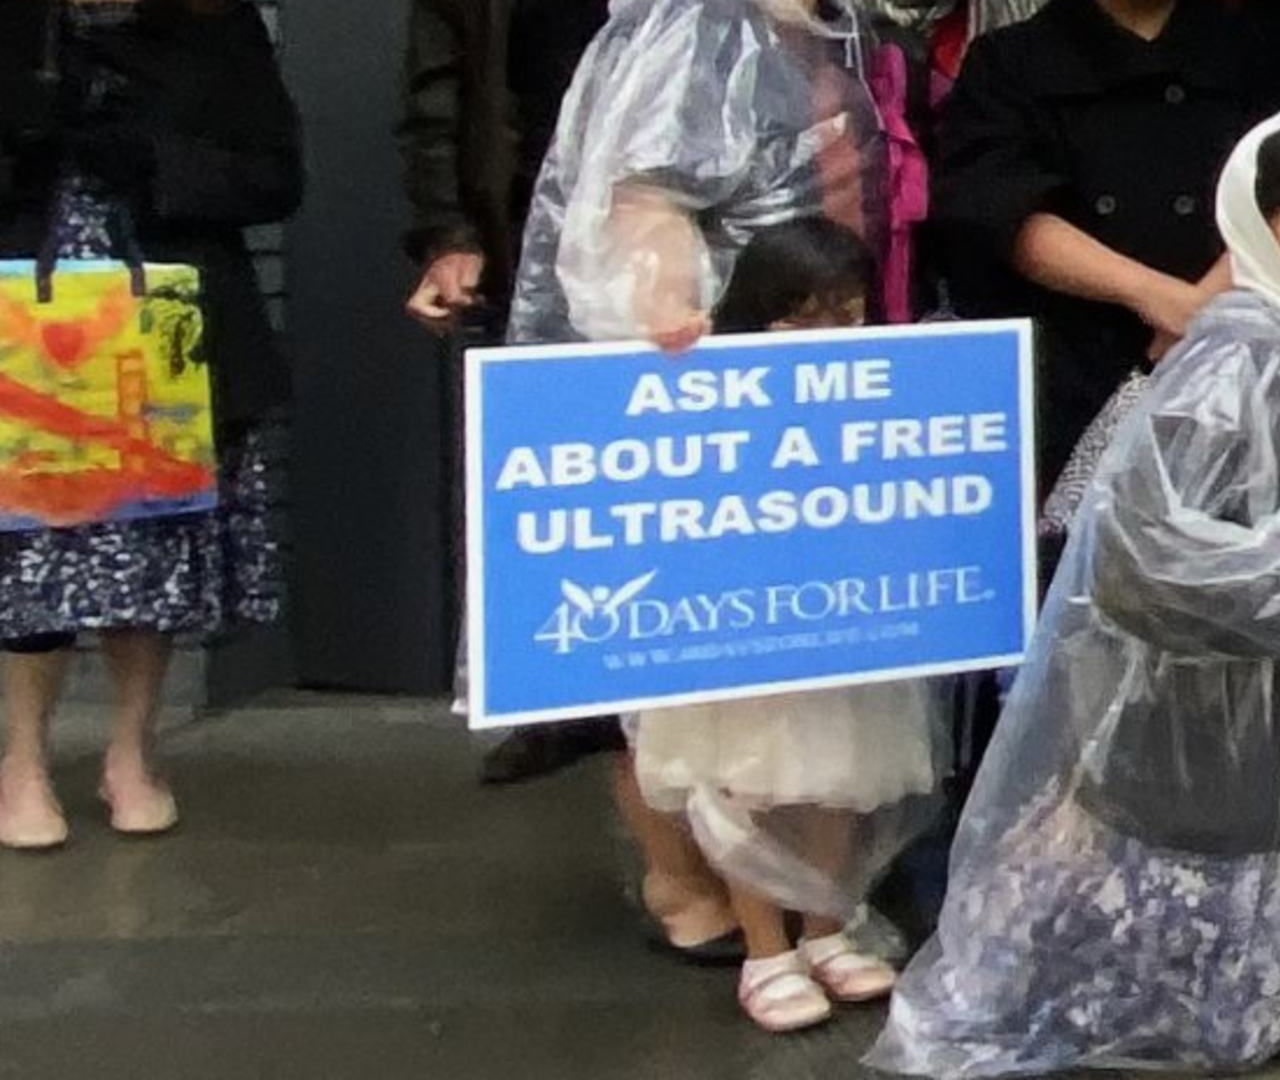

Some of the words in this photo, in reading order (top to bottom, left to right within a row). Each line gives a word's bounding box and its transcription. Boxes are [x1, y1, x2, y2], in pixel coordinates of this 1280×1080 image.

[626, 367, 772, 416] ASK
[794, 359, 891, 404] ME
[496, 431, 750, 490] ABOUT
[772, 427, 819, 469] A
[841, 413, 1008, 463] FREE
[517, 475, 992, 554] ULTRASOUND
